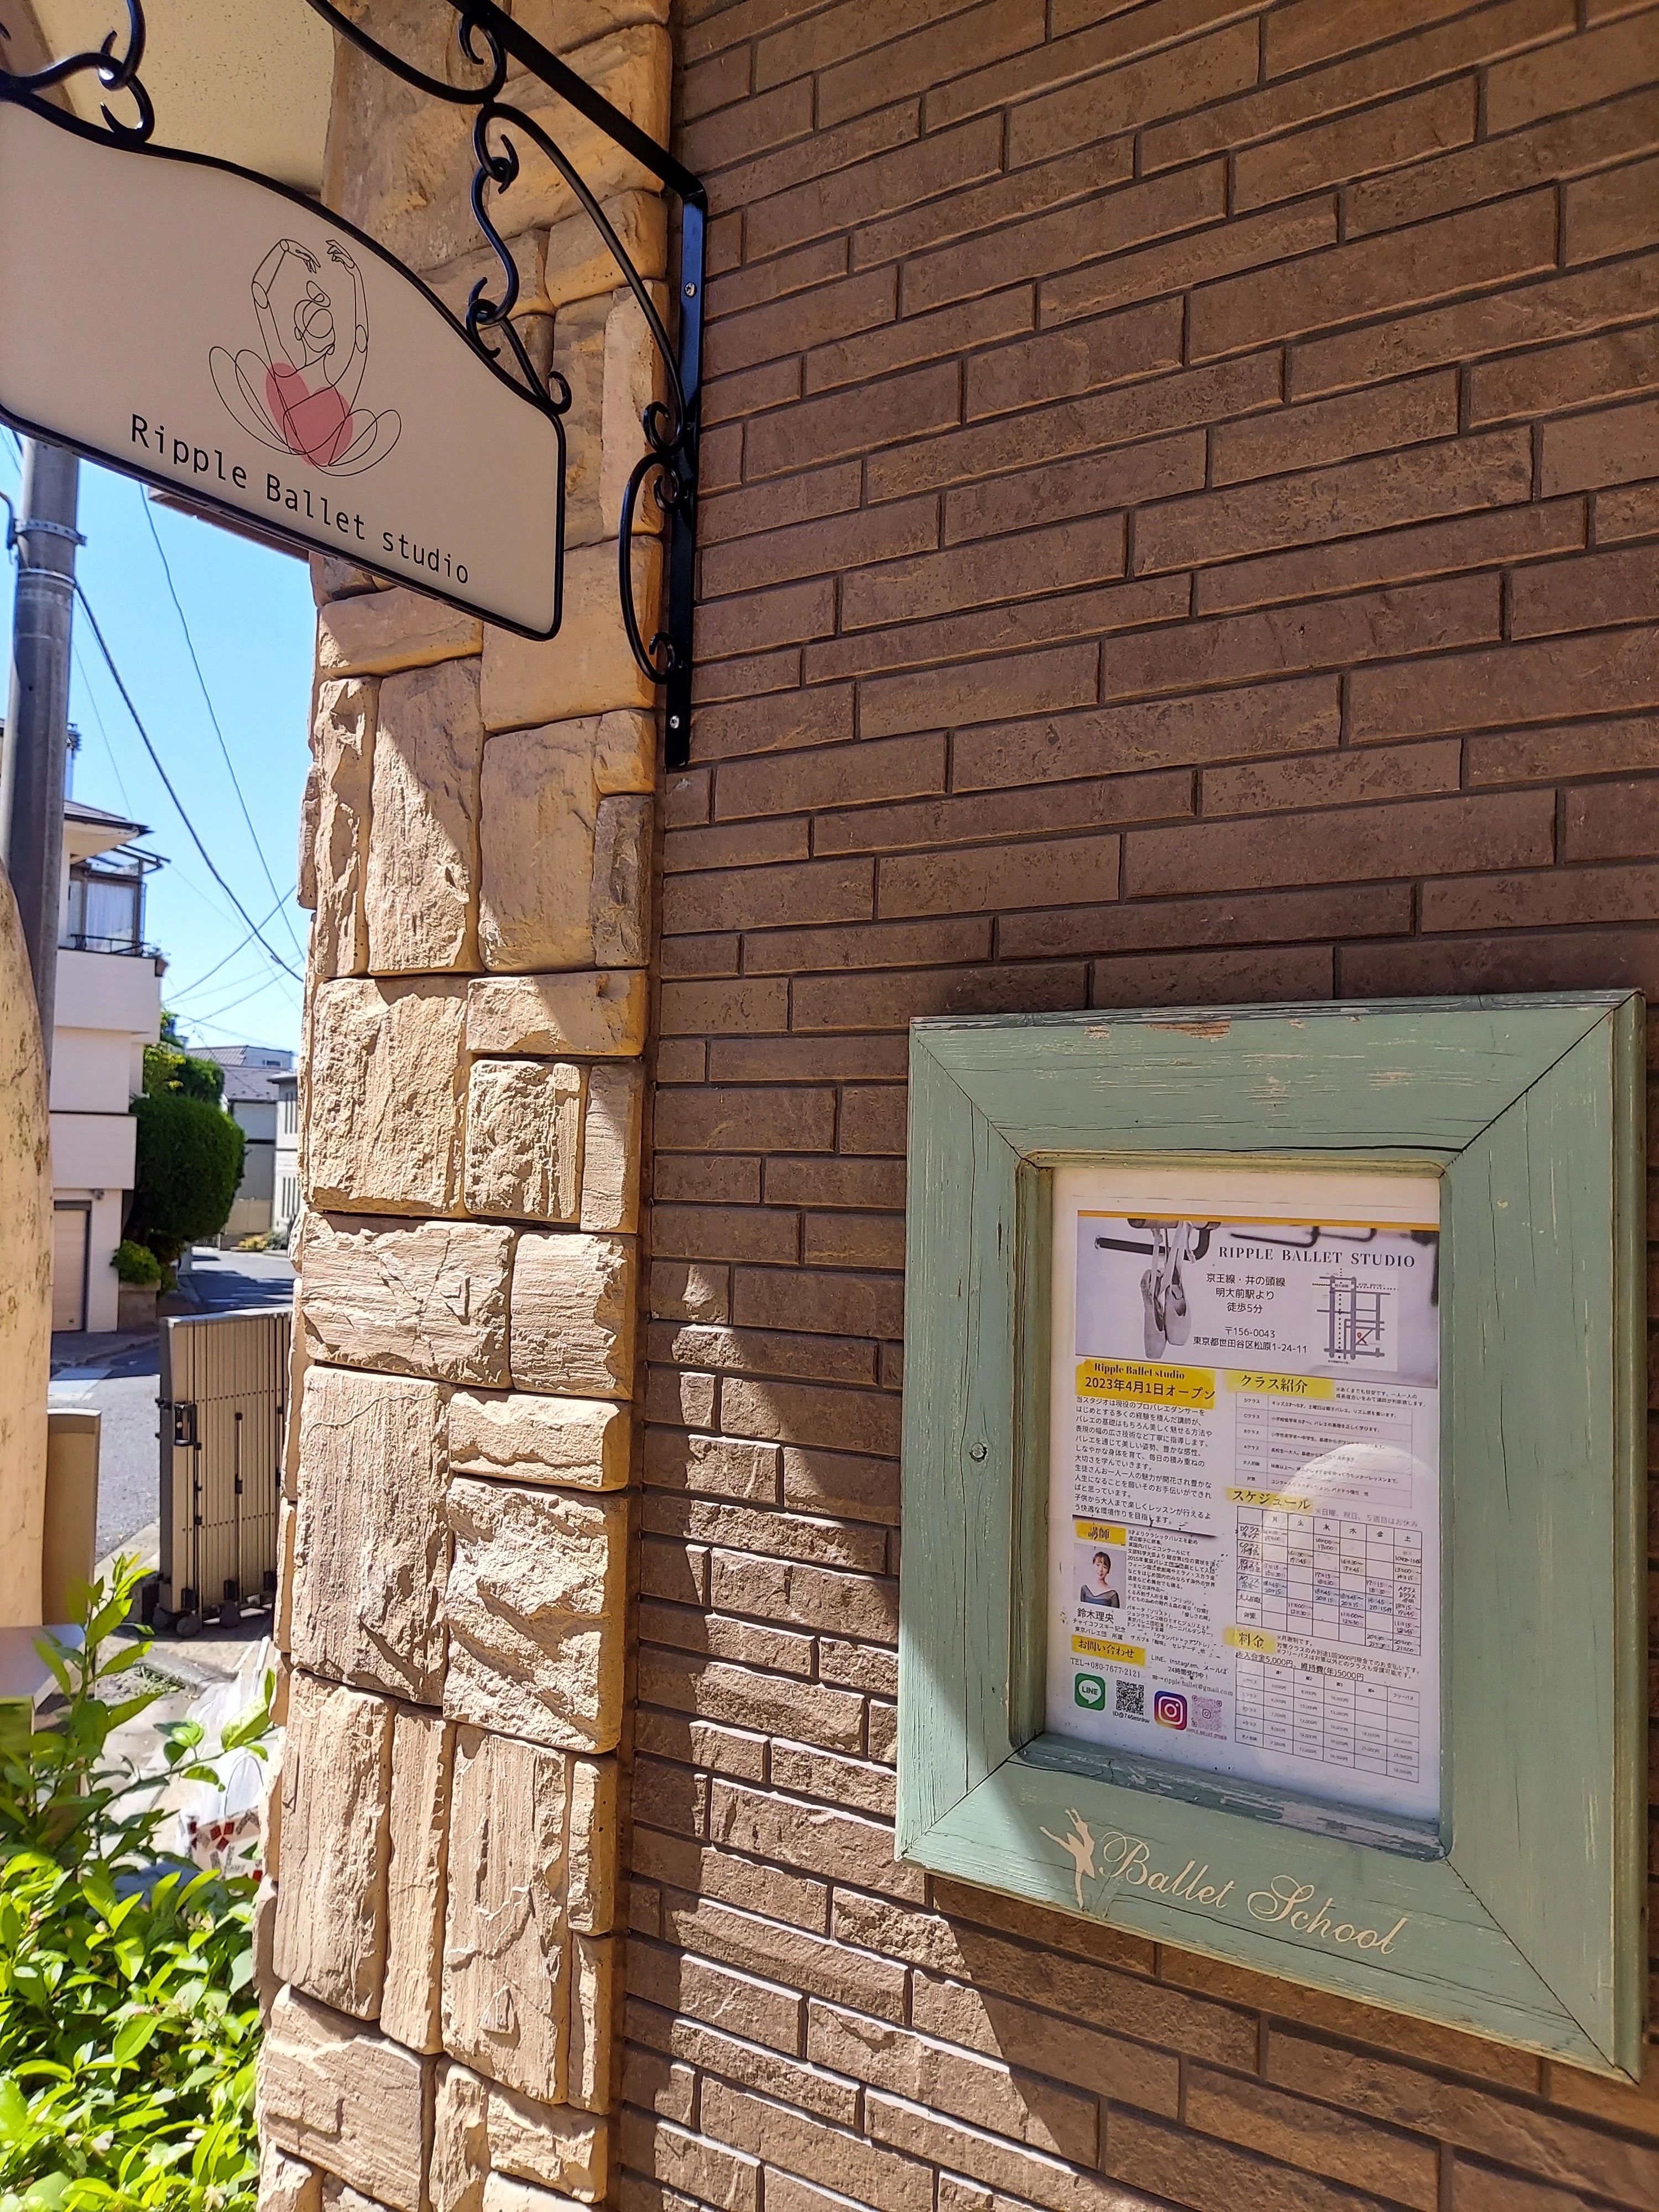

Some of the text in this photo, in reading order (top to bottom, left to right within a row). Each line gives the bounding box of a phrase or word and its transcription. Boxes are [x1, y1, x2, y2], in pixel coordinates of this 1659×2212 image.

[131, 414, 469, 584] Ripple Ballet studio
[1218, 1246, 1416, 1268] RIPPLE BALLET STUDIO
[1206, 1273, 1286, 1287] 京王線・井の頭線
[1215, 1287, 1275, 1300] 明大前駅より
[1227, 1302, 1263, 1314] 徒歩5分
[1224, 1326, 1276, 1338] 〒156-0043
[1193, 1336, 1307, 1354] 東京都世田谷区松原1-24-11
[1094, 1362, 1185, 1380] Ripple Ballet studio
[1085, 1376, 1215, 1400] 2023年4月1日オープン
[1240, 1374, 1308, 1394] クラス紹介
[1076, 1396, 1206, 1417] 当スタジオは現役のプロバレエダンサーを
[1232, 1490, 1311, 1510] スケジュール
[1088, 1527, 1110, 1540] 講師
[1322, 1523, 1331, 1532] 水
[1077, 1607, 1114, 1624] 鈴木理央
[1073, 1618, 1126, 1633] チャイコフスキー記念
[1078, 1639, 1135, 1659] お問い合わせ
[1239, 1631, 1265, 1649] 料金
[1082, 1686, 1099, 1696] LINE
[1098, 1830, 1409, 1955] Ballet School
